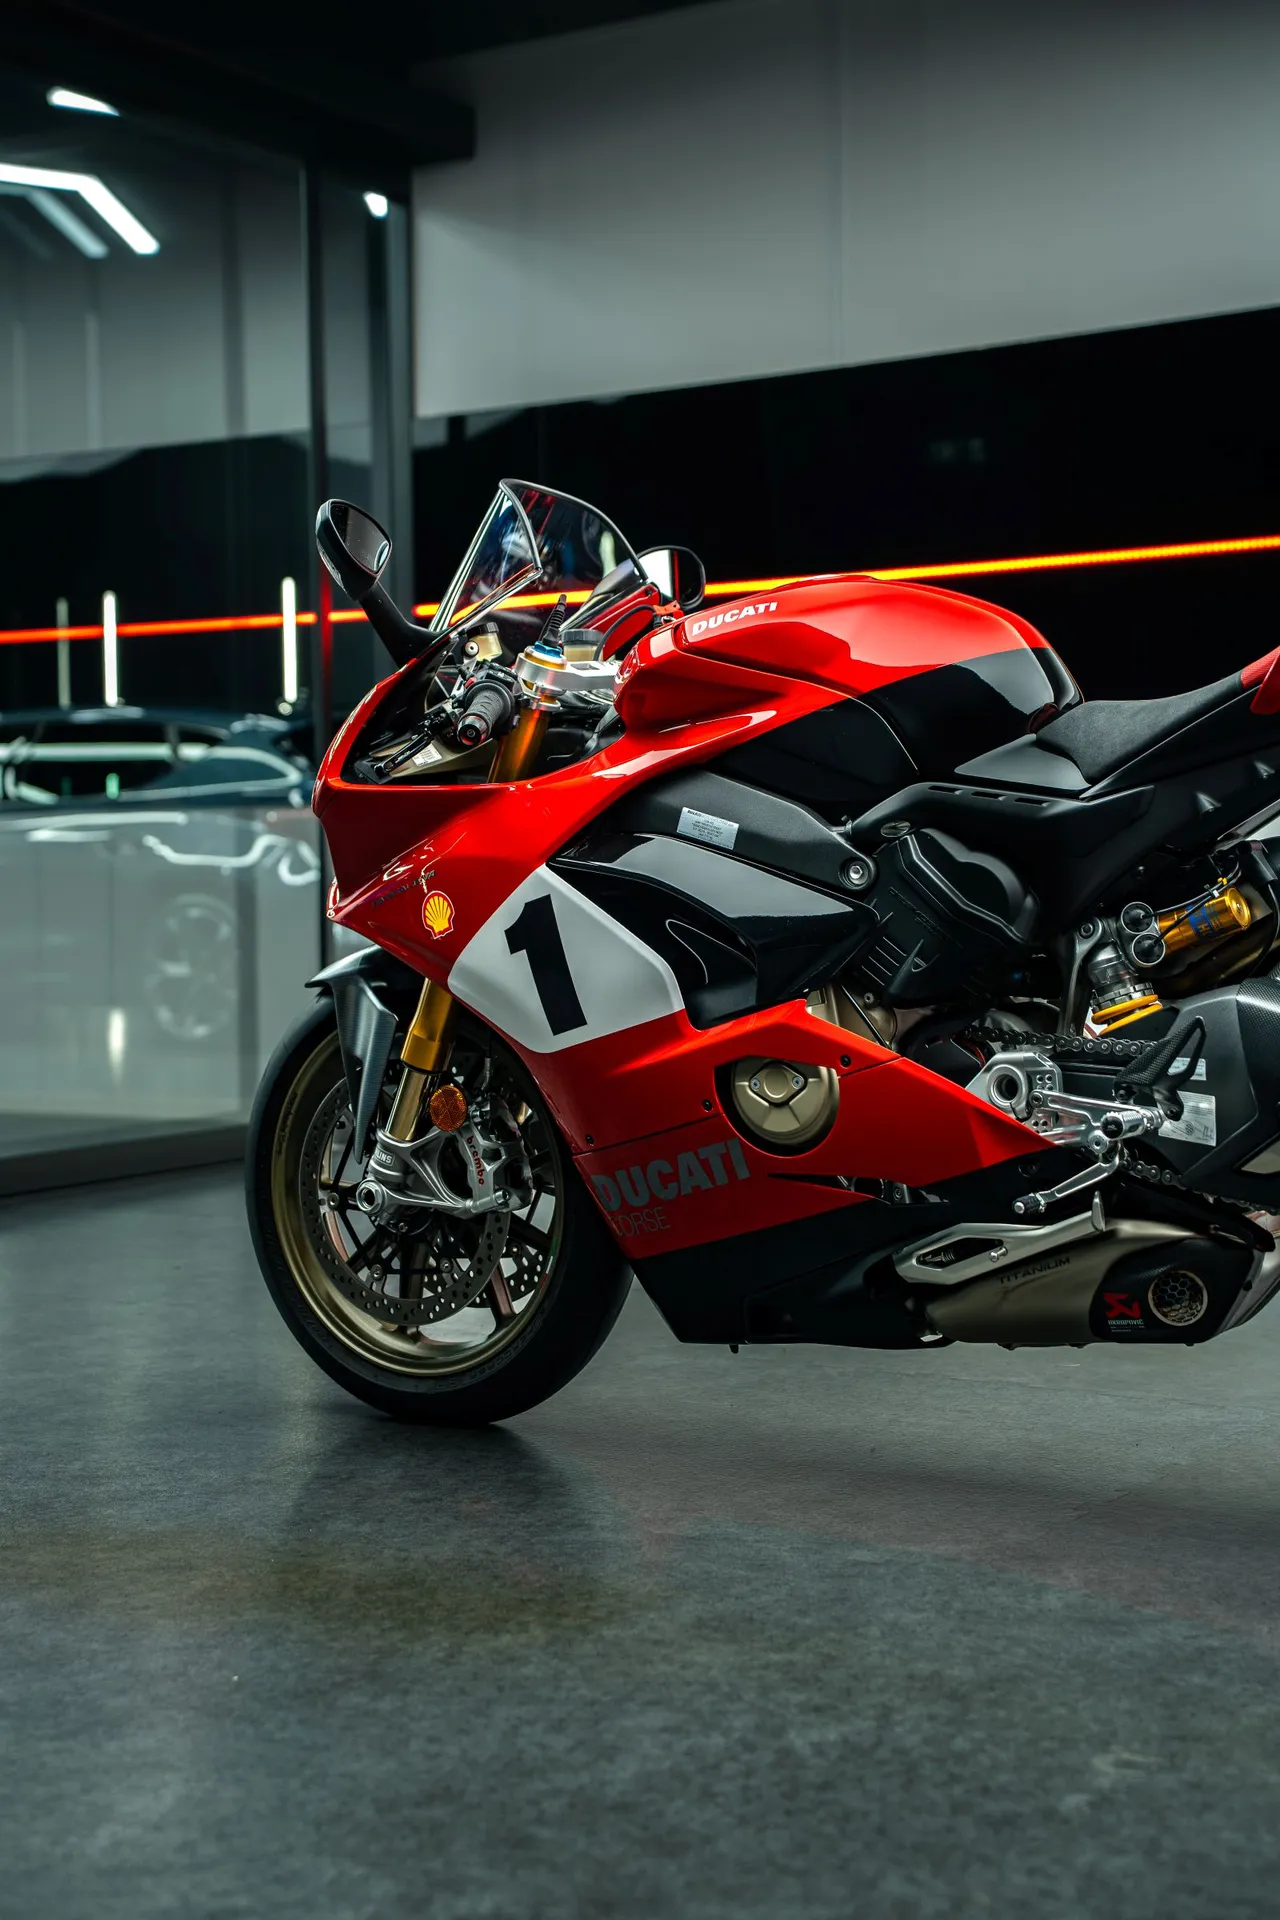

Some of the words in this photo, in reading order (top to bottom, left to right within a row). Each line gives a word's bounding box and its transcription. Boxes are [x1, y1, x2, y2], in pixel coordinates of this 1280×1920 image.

[692, 602, 778, 636] DUCATI
[504, 894, 588, 1036] 1
[466, 1136, 485, 1186] brembo
[591, 1137, 751, 1212] DUCATI
[997, 1256, 1071, 1284] TITANIUM
